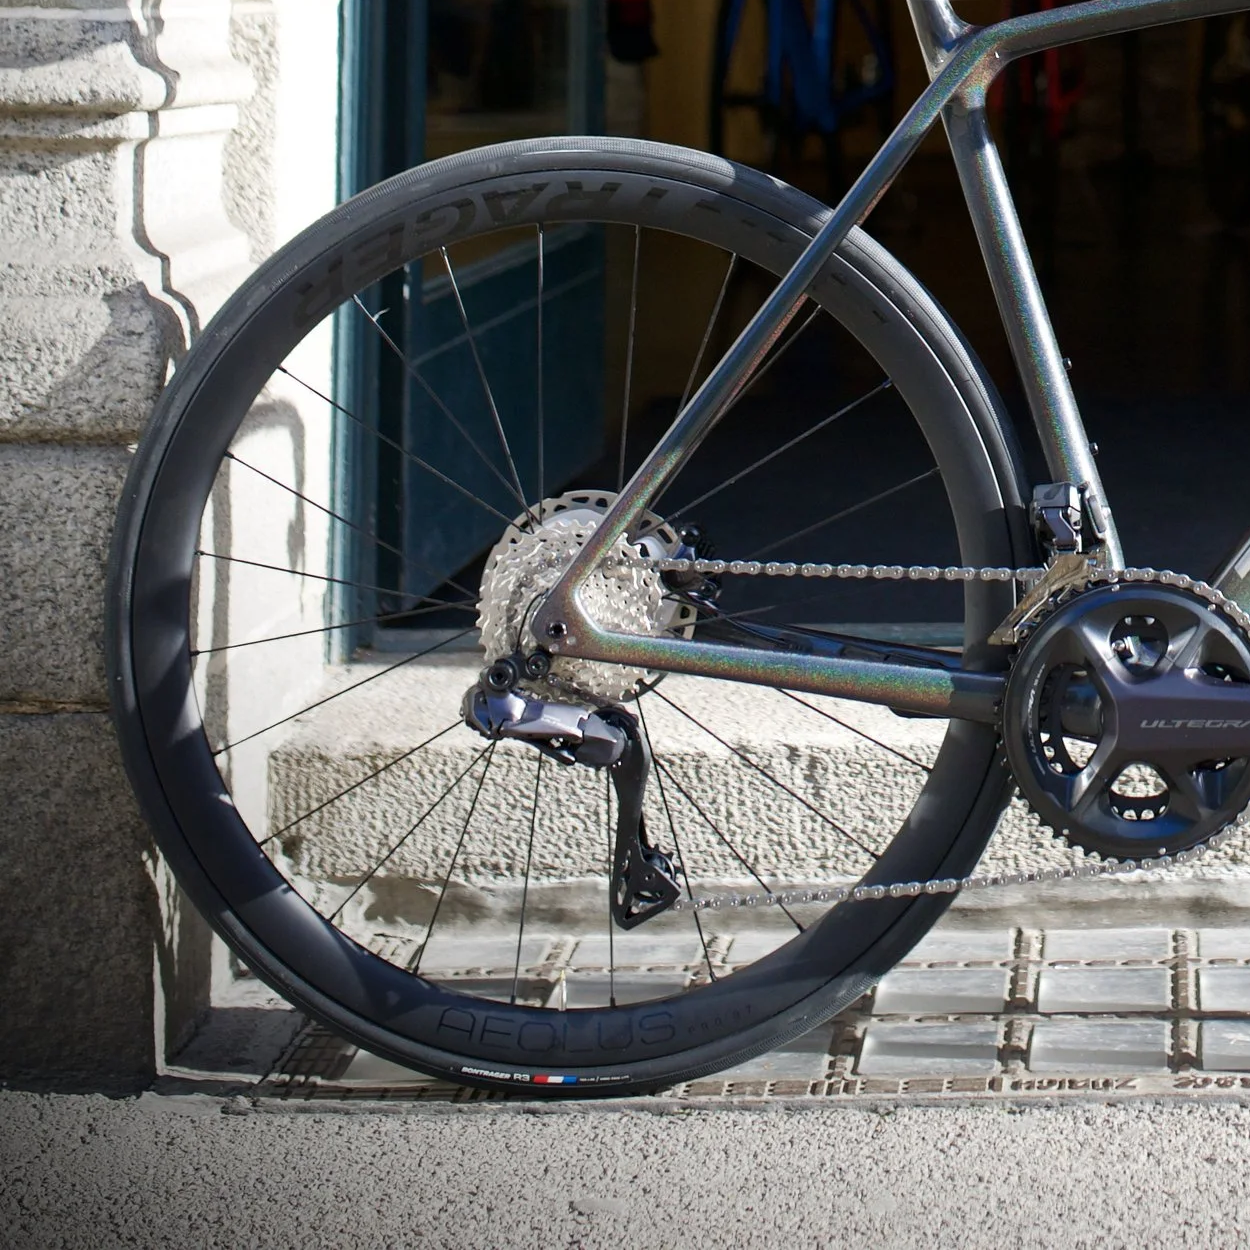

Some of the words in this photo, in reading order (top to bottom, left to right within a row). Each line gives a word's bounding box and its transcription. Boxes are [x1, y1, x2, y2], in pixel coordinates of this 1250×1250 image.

[436, 1006, 677, 1053] AEOLUS
[461, 1066, 512, 1080] BONTRAGER
[513, 1071, 531, 1082] R3
